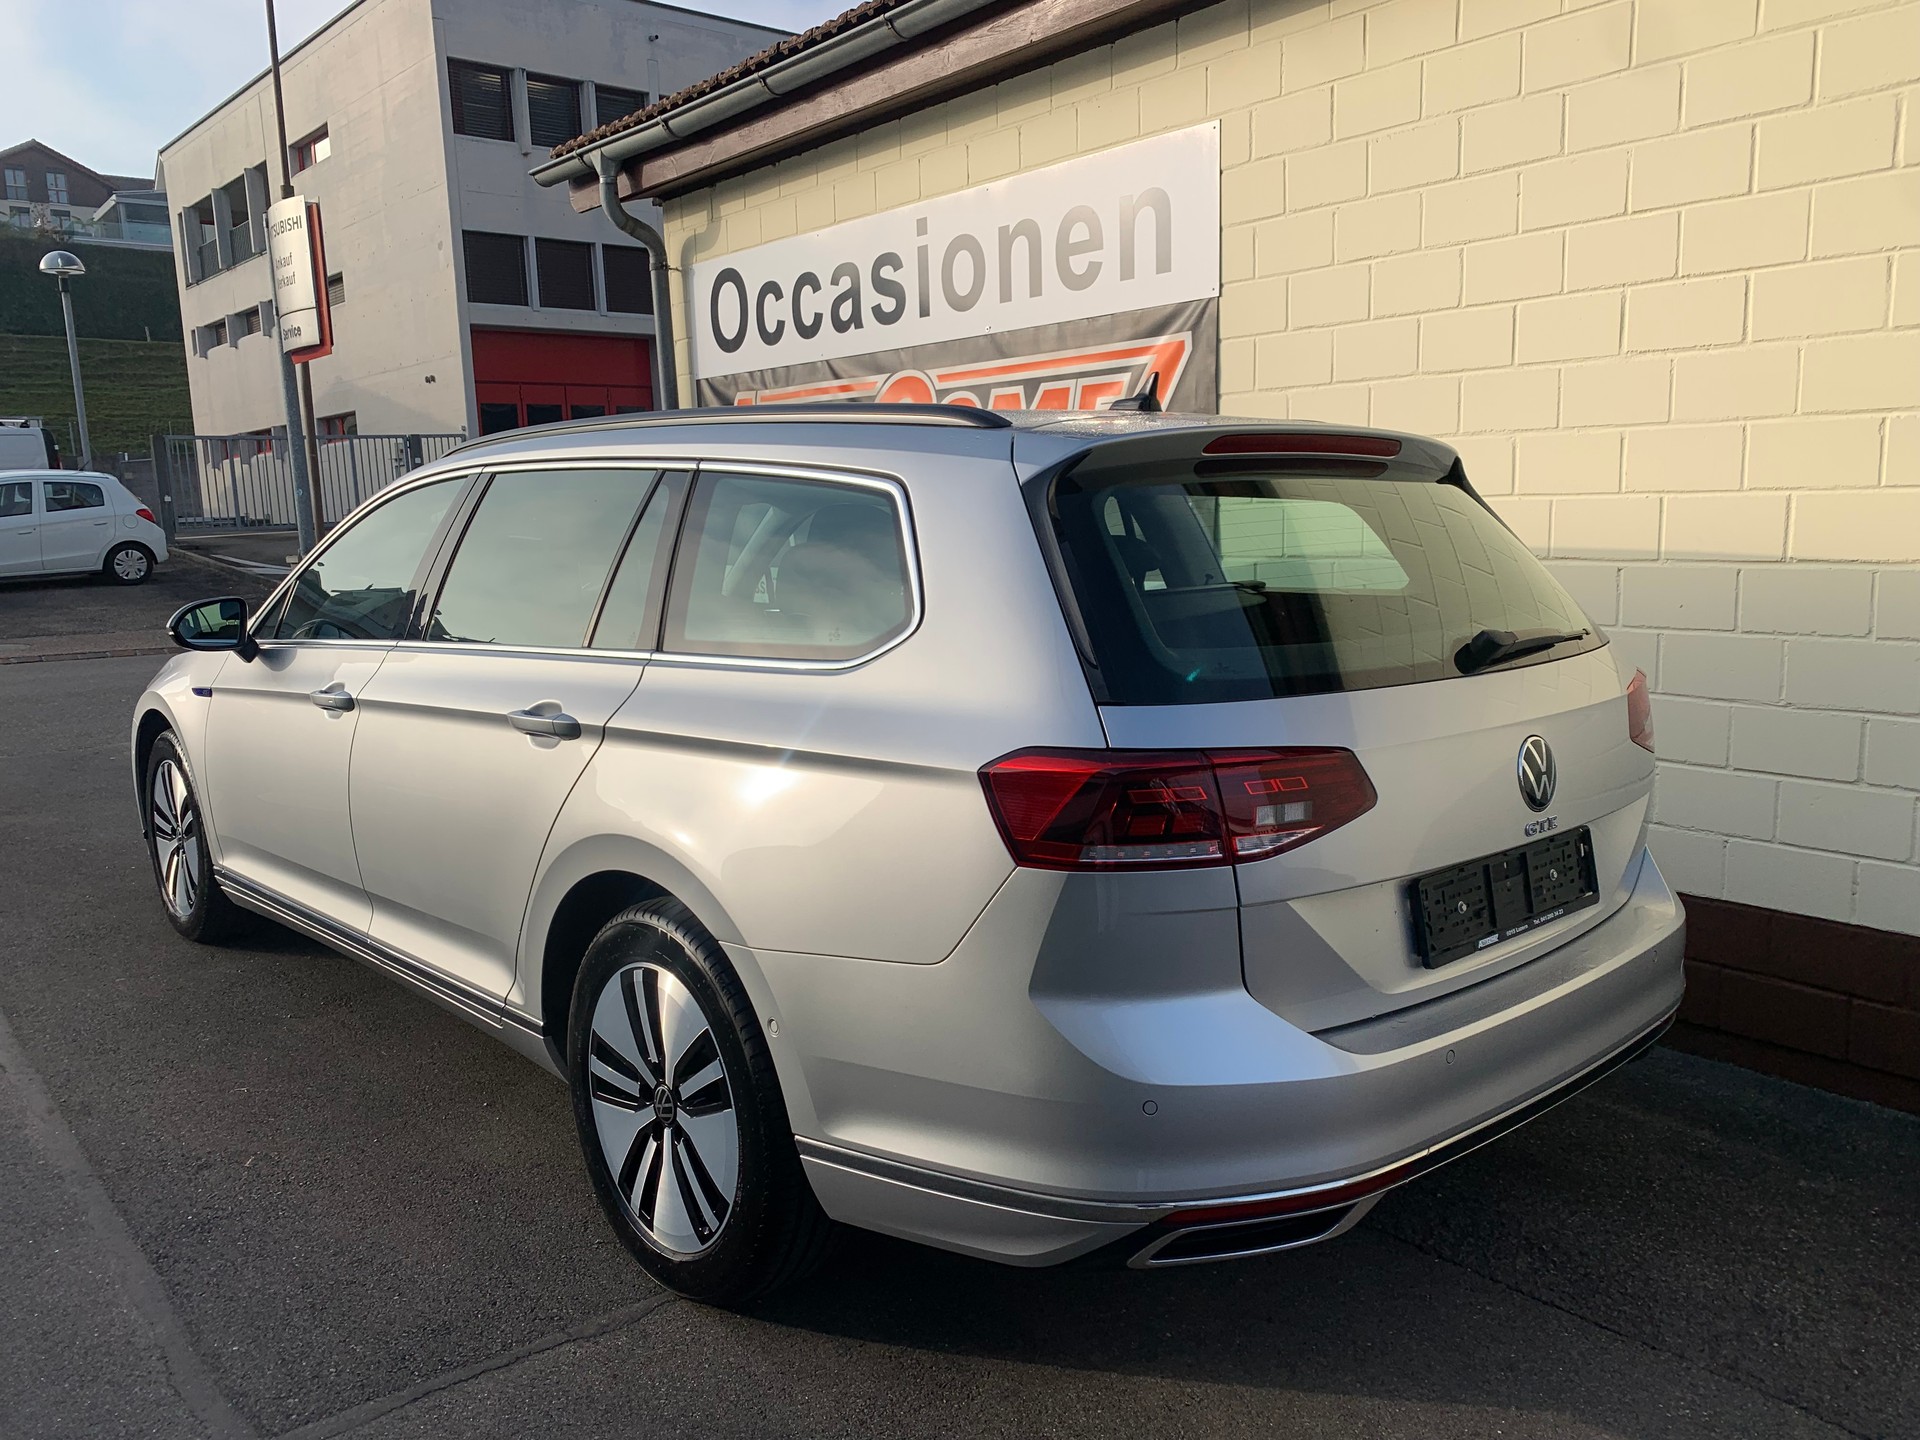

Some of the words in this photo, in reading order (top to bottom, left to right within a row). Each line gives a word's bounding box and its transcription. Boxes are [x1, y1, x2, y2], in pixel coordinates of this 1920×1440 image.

[709, 186, 1173, 354] Occasionen
[282, 324, 302, 341] Service
[1519, 736, 1556, 804] VW
